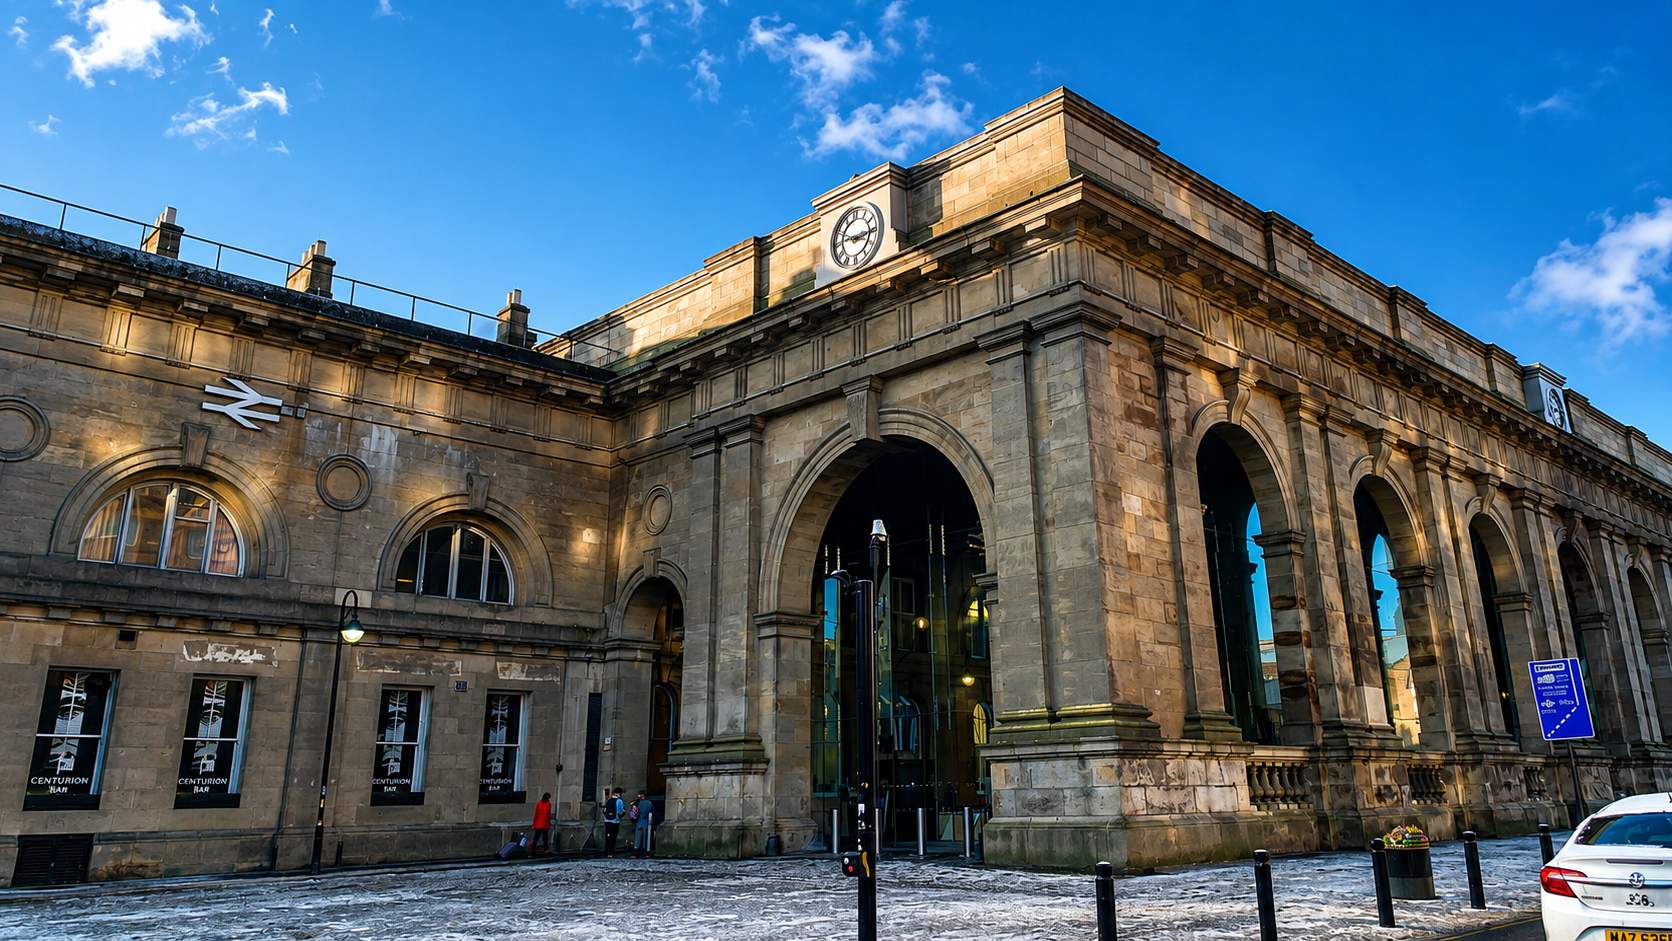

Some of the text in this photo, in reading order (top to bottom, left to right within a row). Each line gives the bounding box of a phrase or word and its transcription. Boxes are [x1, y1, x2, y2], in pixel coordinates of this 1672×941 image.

[30, 776, 89, 785] CENTURION
[178, 777, 228, 785] CENTURION
[49, 786, 68, 794] BAR
[193, 786, 210, 794] BAR
